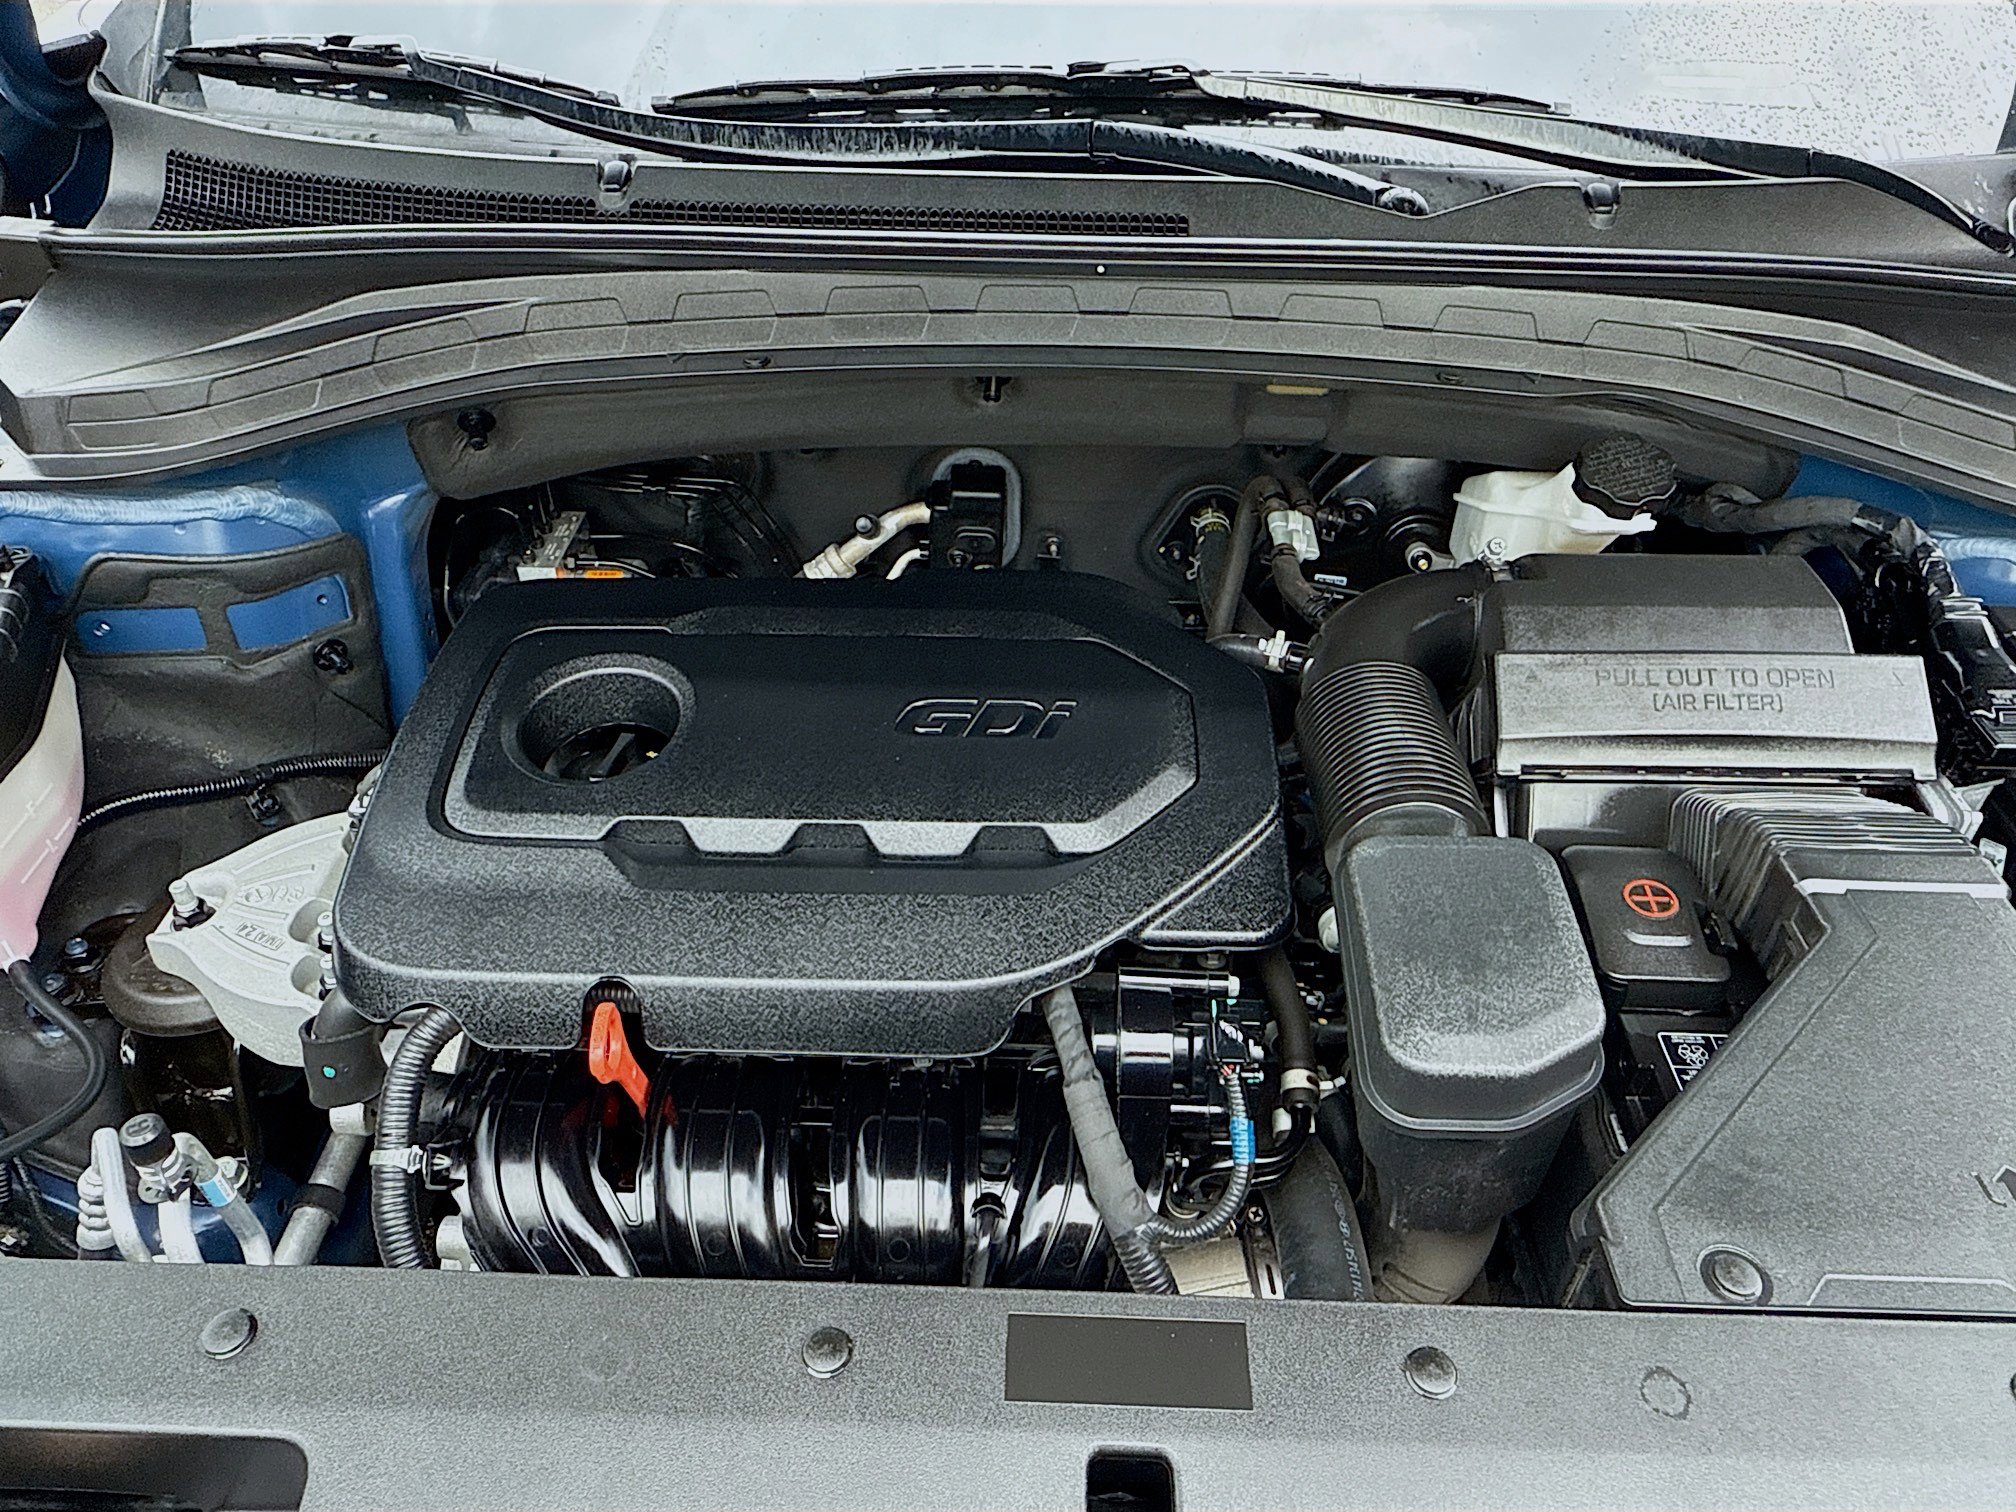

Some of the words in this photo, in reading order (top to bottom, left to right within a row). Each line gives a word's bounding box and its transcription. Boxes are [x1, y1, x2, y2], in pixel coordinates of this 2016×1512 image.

[1594, 667, 1660, 687] PULL
[1666, 667, 1718, 687] OUT
[1725, 668, 1758, 688] TO
[1766, 668, 1834, 689] OPEN
